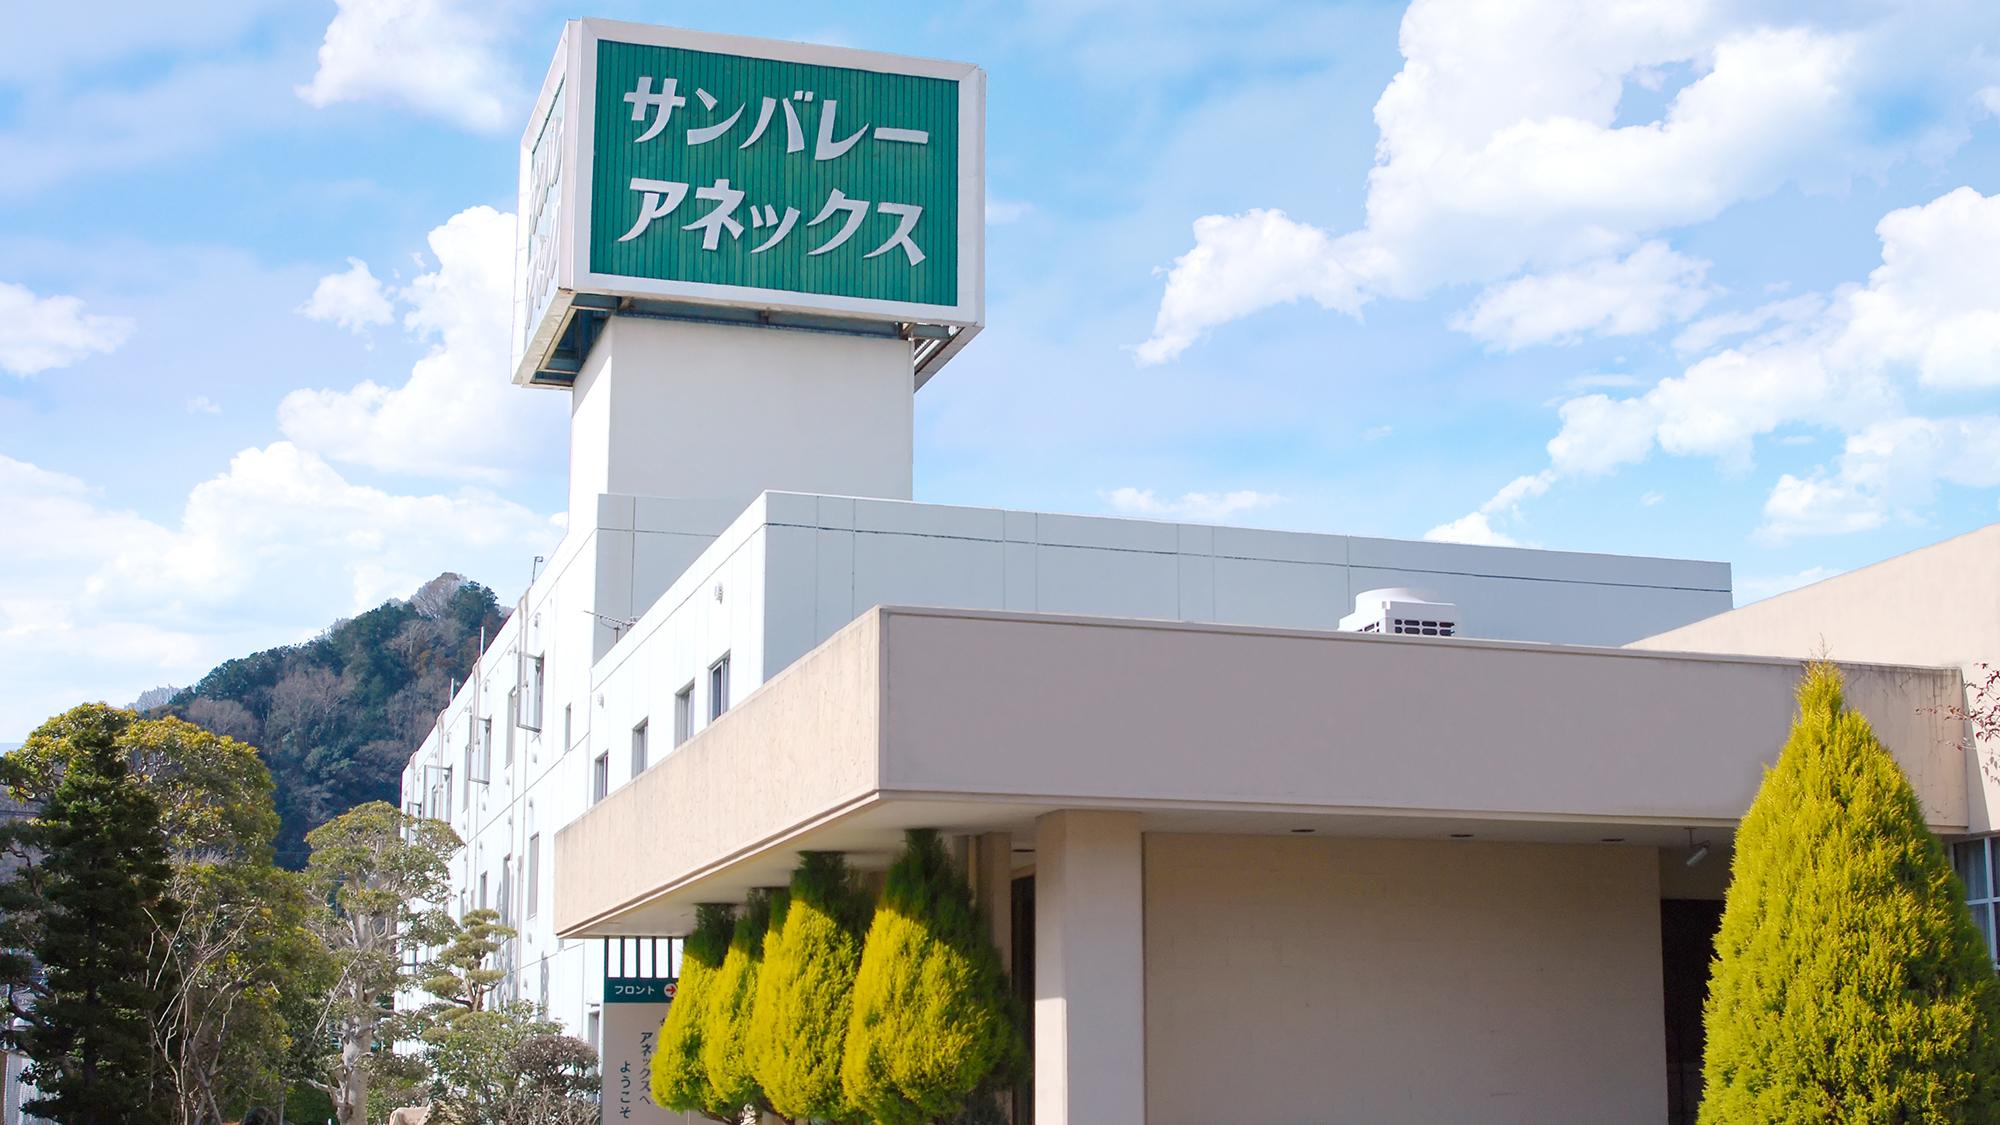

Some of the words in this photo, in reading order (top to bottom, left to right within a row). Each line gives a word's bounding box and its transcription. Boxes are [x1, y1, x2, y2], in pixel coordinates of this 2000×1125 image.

[624, 76, 929, 161] サンバレー
[618, 178, 926, 267] アネックス
[614, 984, 656, 996] フロント
[619, 1060, 631, 1119] ようこそ
[639, 1031, 653, 1105] アネックスへ
